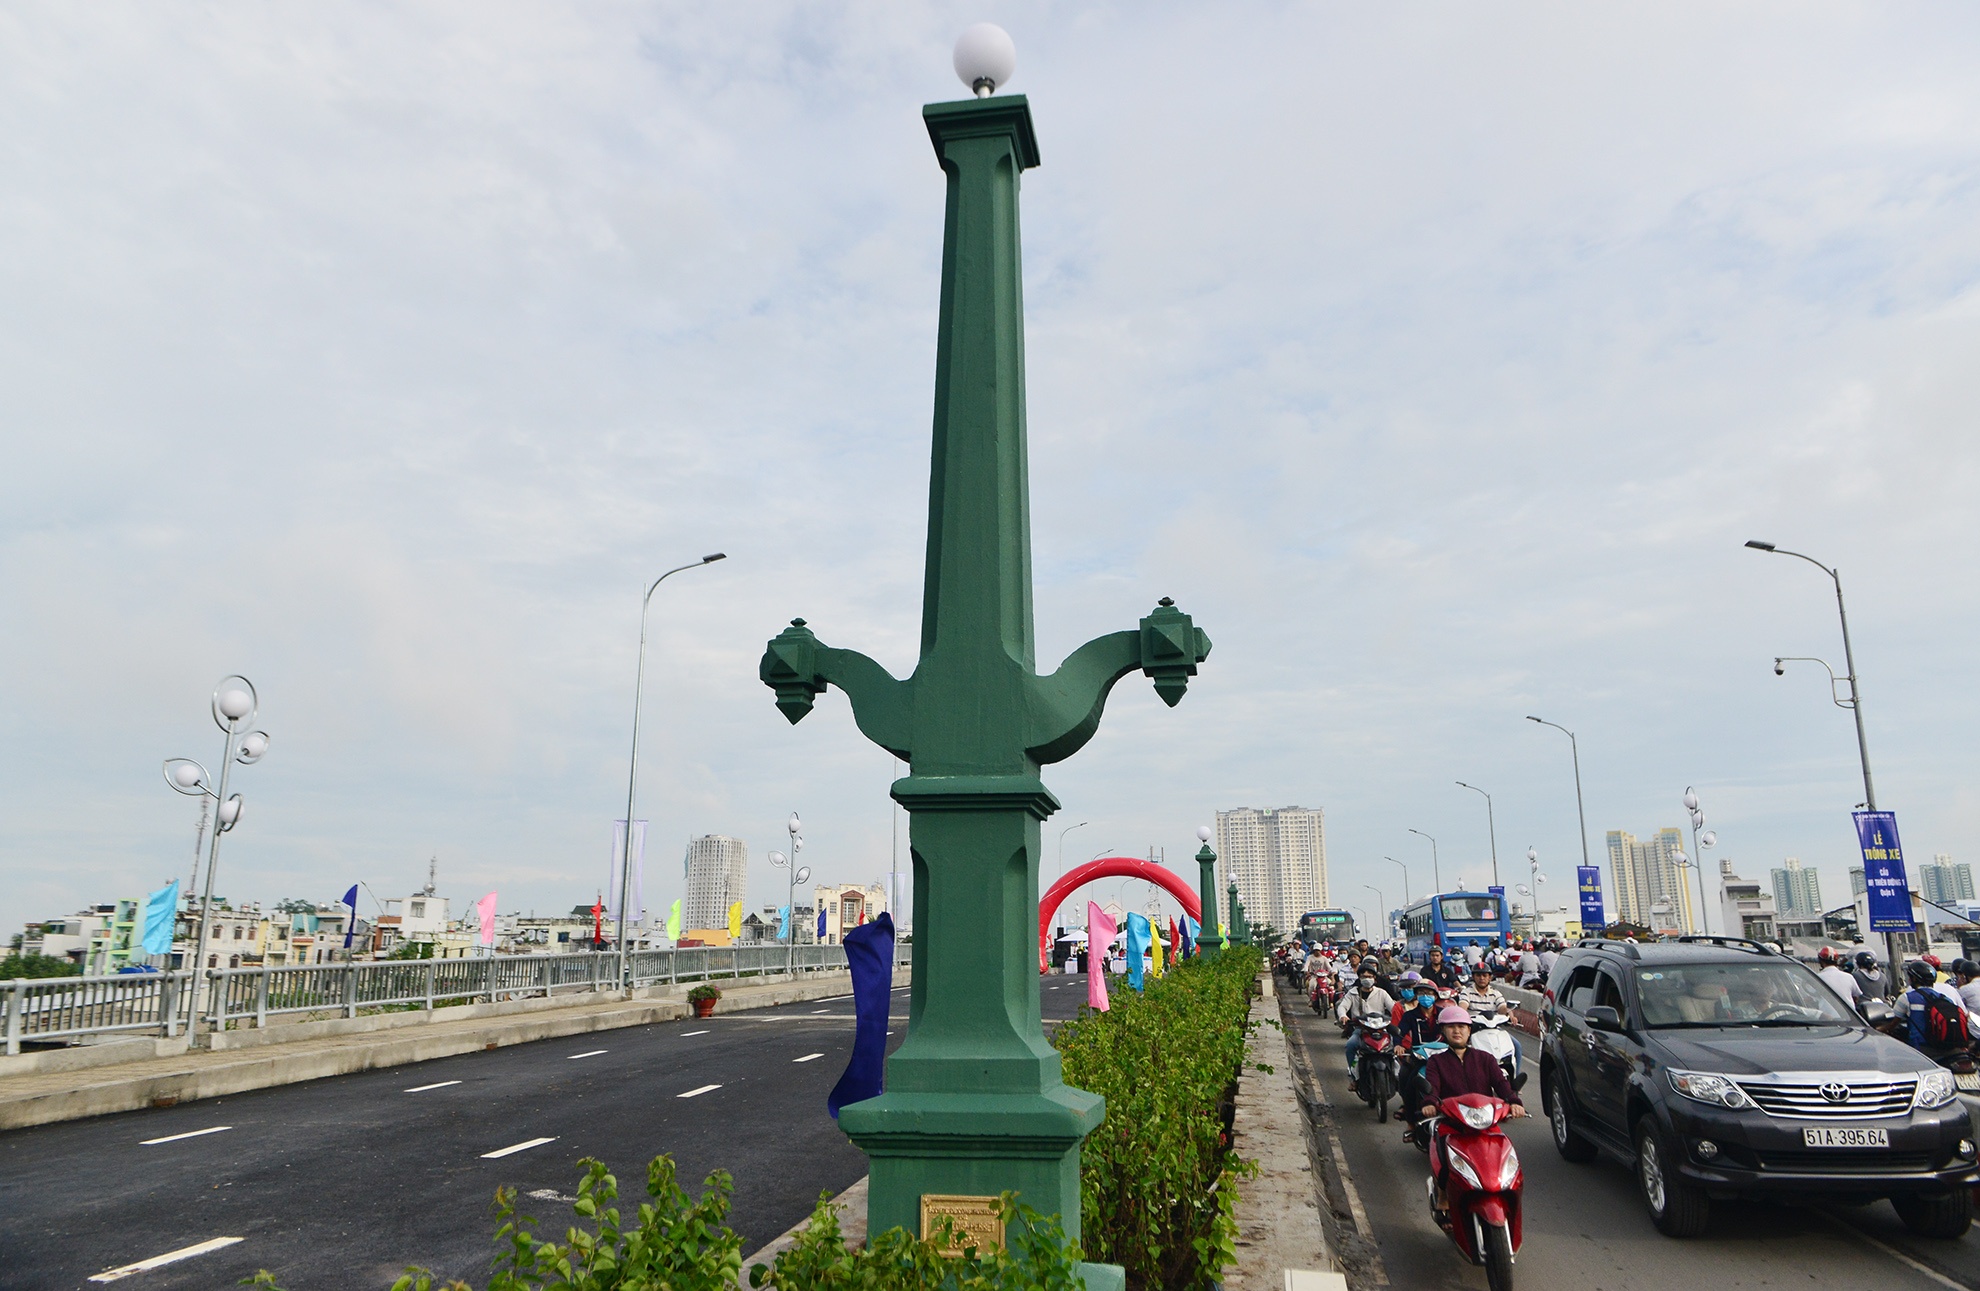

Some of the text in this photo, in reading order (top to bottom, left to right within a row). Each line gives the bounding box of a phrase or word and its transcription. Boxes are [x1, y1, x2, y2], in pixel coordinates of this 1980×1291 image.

[1864, 848, 1901, 860] THÔNG XE
[1806, 1129, 1886, 1146] 51A-395.64
